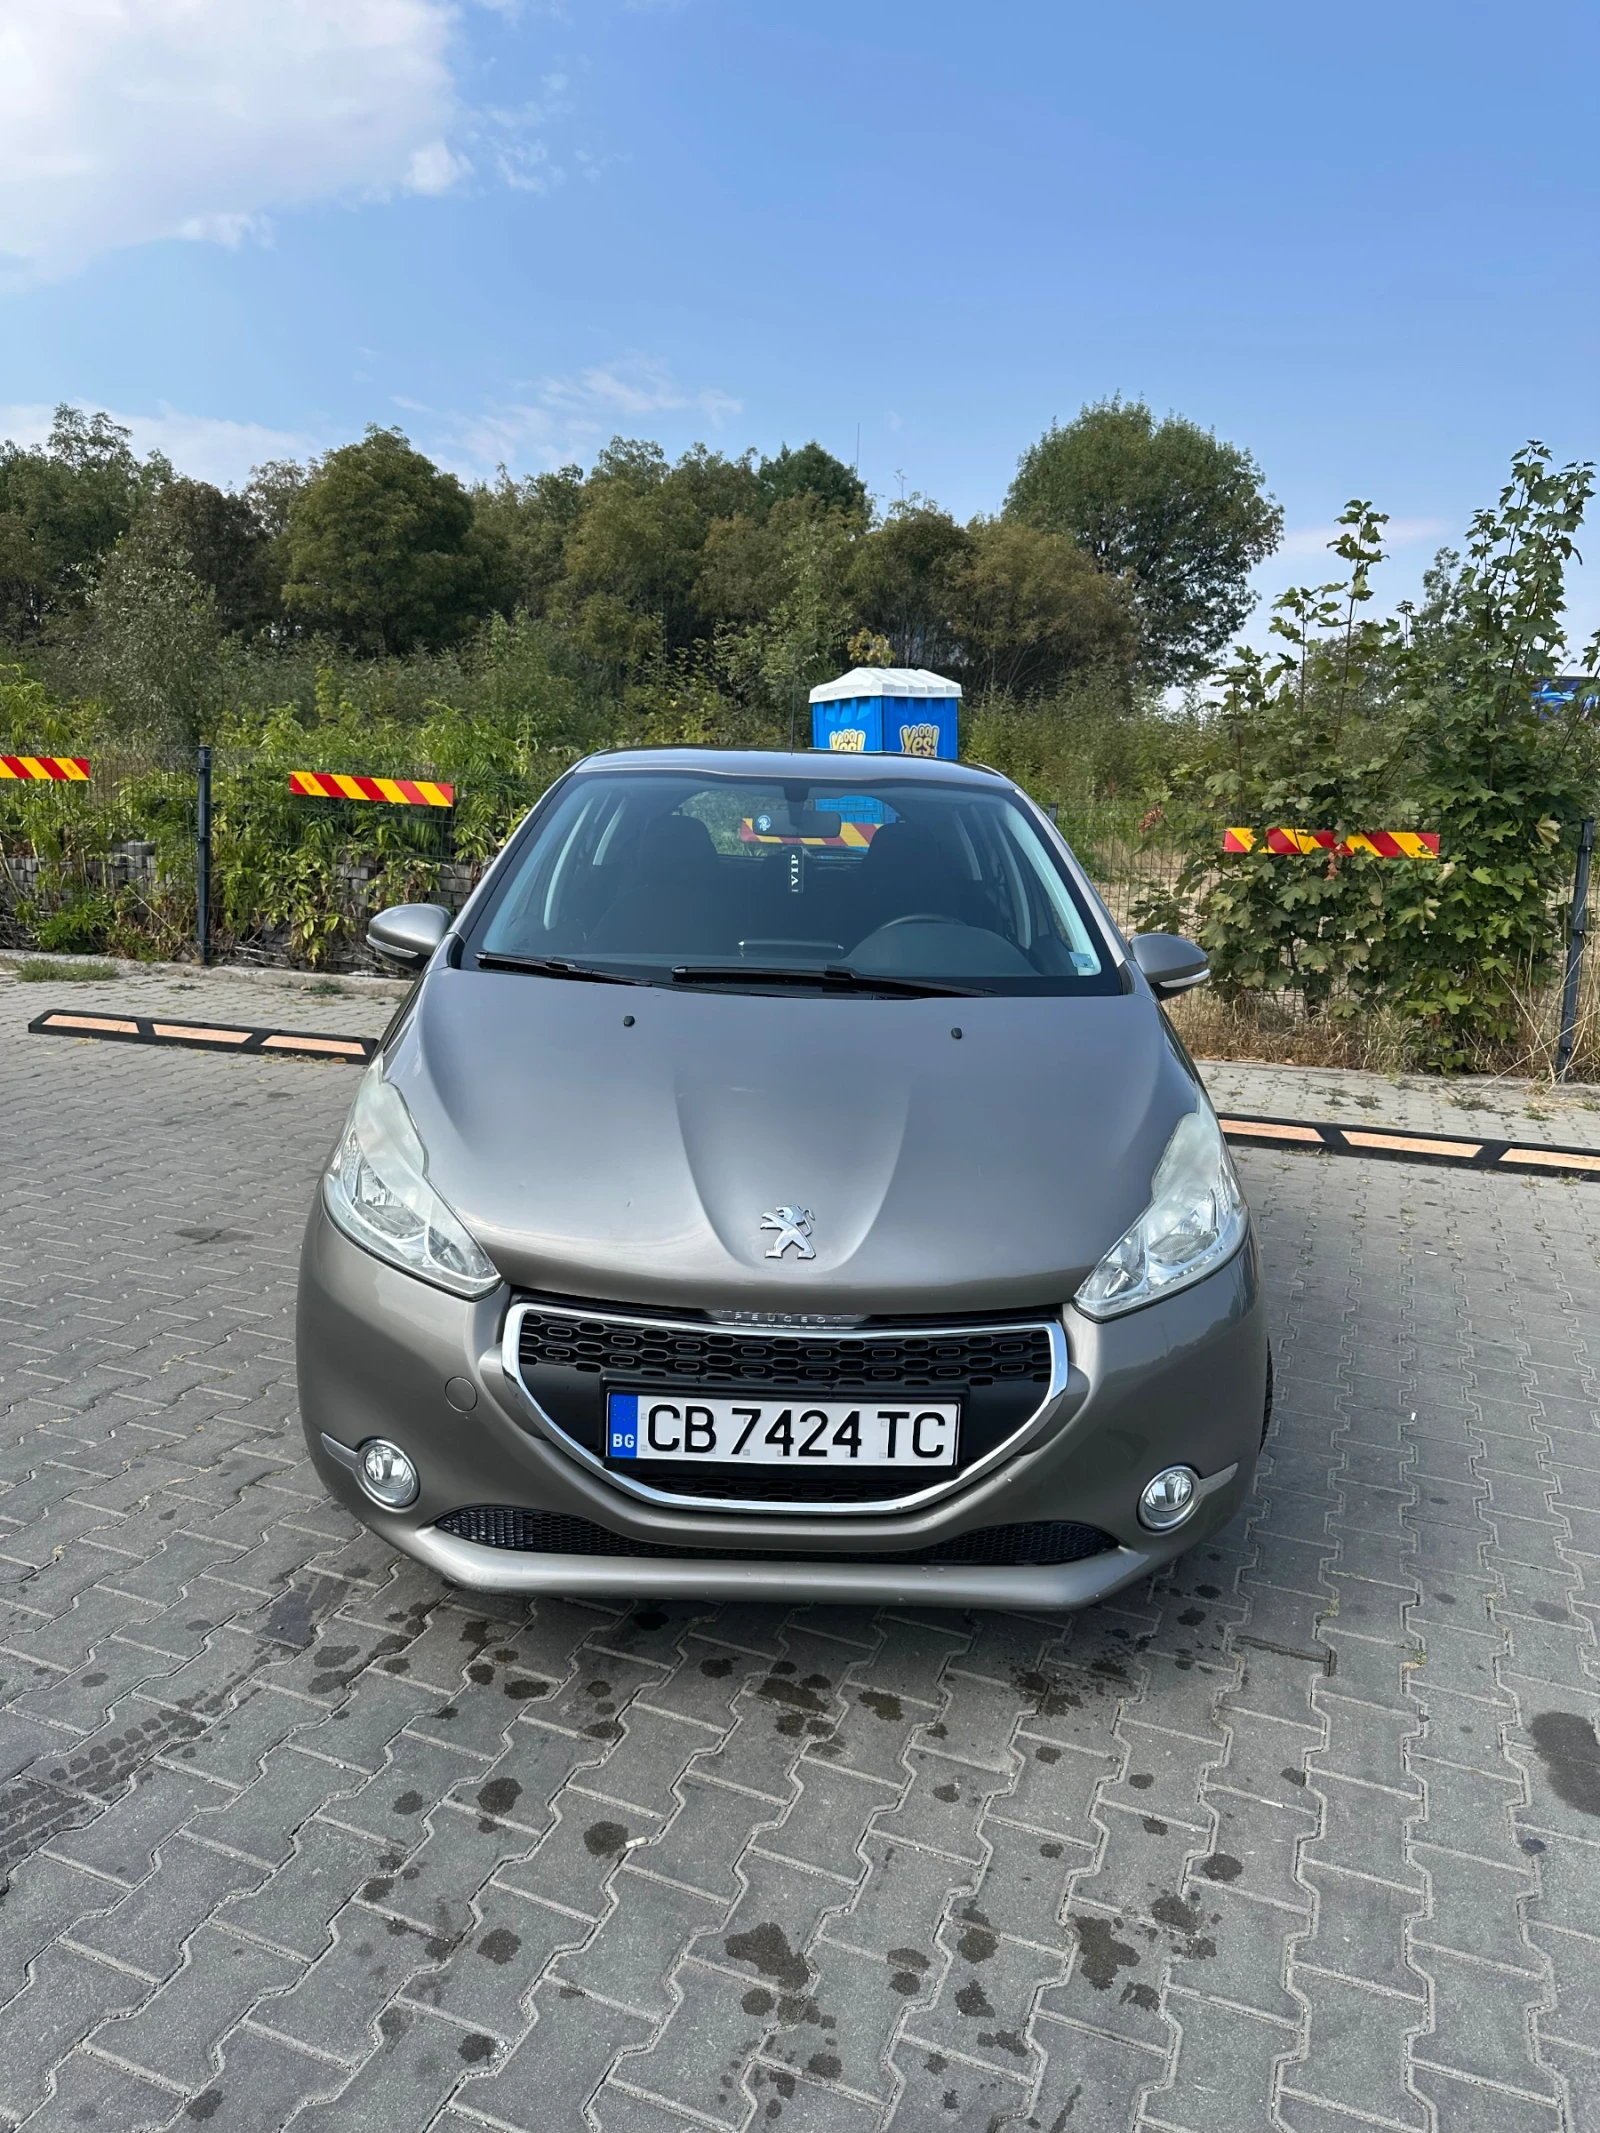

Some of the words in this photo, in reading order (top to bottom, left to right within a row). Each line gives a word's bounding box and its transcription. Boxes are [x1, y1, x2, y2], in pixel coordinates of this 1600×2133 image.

[612, 1433, 635, 1449] BG
[647, 1404, 717, 1453] CB
[730, 1407, 862, 1458] 7424
[877, 1411, 945, 1459] TC
